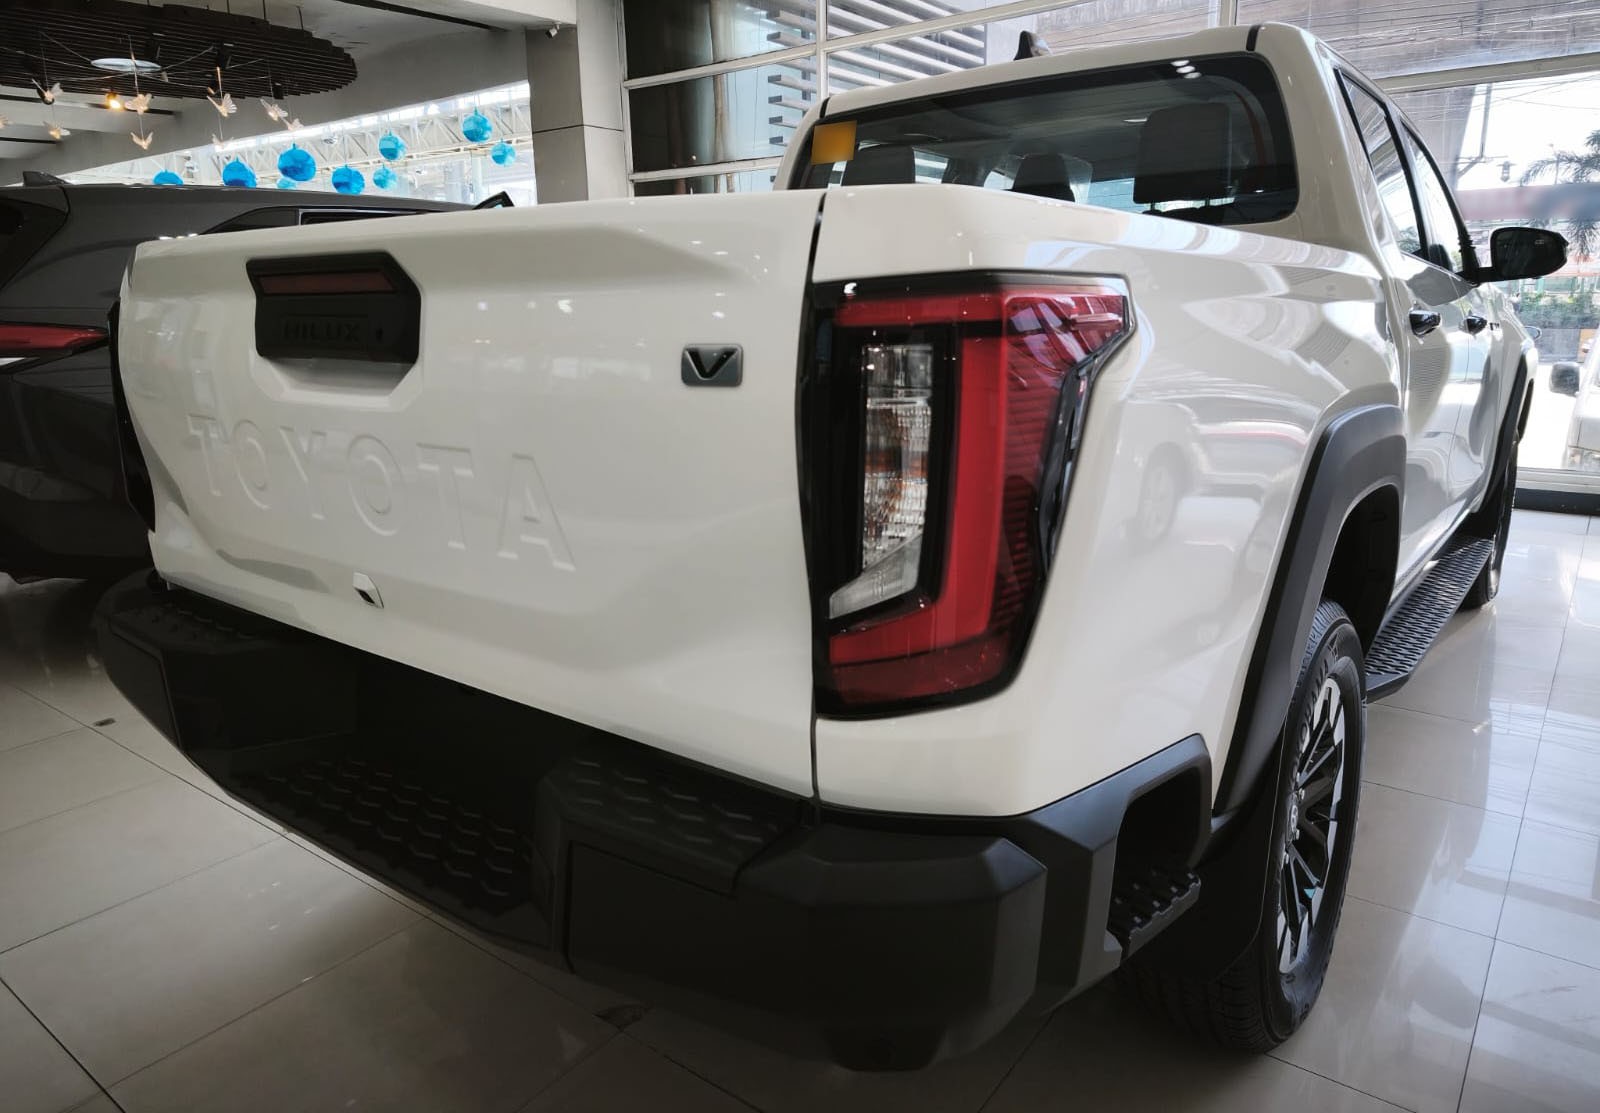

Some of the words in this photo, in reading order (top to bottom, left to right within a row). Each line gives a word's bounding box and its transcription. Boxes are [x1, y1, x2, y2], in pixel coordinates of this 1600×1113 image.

[283, 320, 361, 342] HILUX
[684, 346, 739, 380] V
[186, 413, 576, 572] TOYOTA
